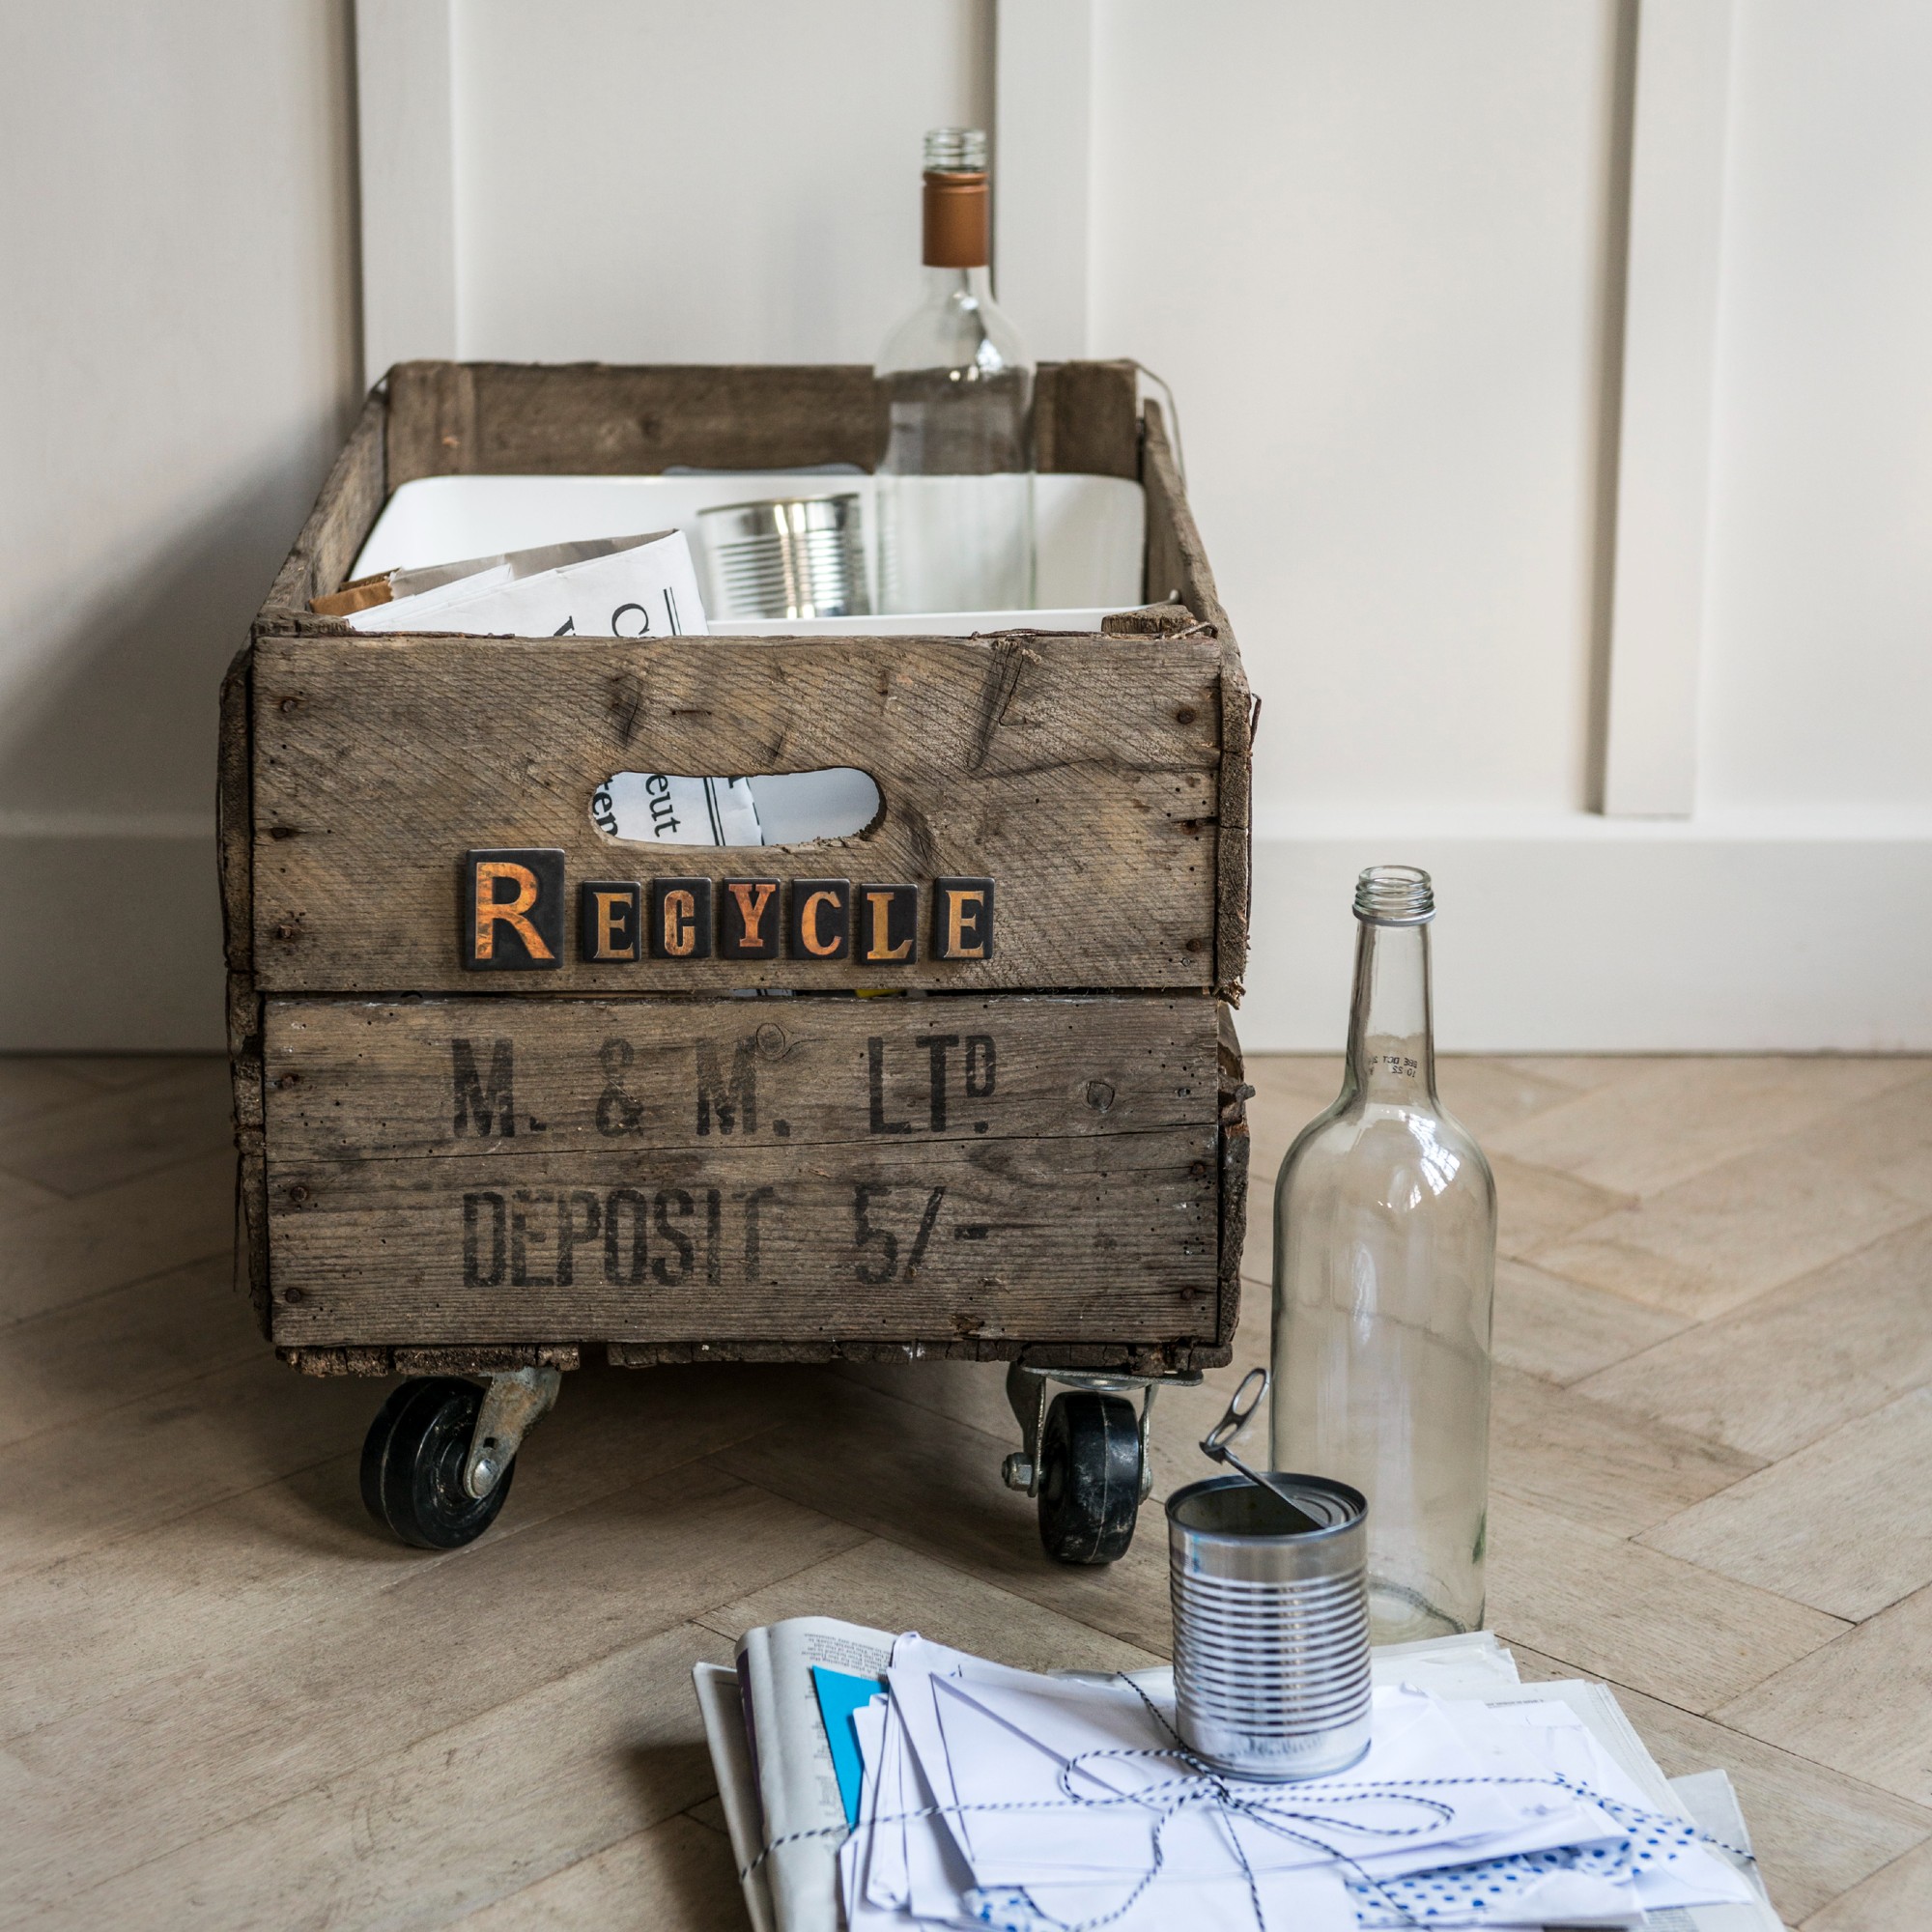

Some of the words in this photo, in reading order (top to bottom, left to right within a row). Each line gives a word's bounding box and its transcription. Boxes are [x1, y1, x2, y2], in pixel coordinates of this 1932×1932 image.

[474, 862, 985, 961] RECYCLE
[451, 1037, 548, 1138] M.
[595, 1037, 644, 1137] &
[696, 1037, 791, 1137] M.
[462, 1186, 775, 1288] DEPOSIT
